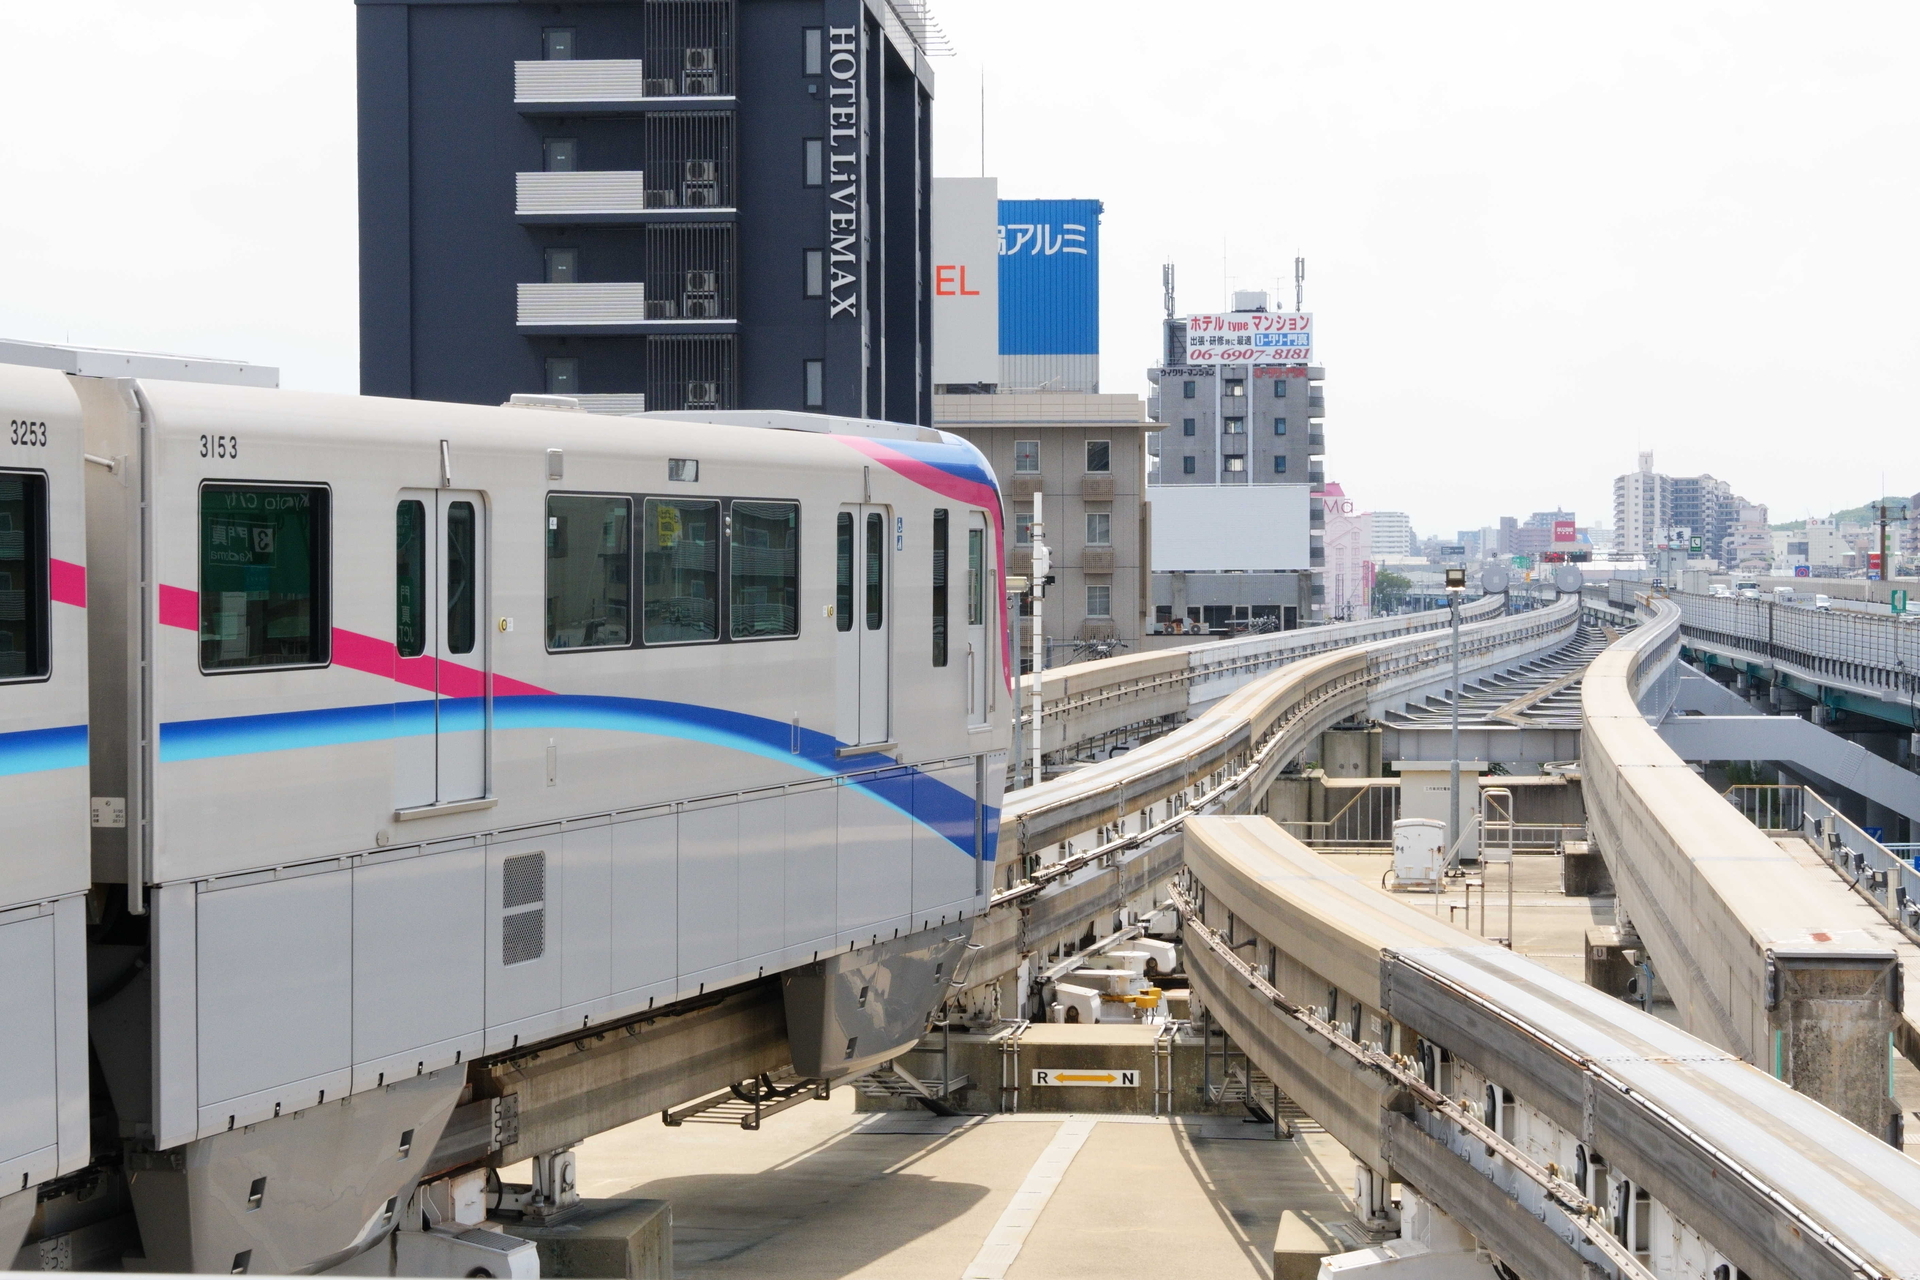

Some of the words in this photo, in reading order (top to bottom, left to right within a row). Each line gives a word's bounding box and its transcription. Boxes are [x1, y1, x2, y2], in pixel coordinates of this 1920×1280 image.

[830, 24, 857, 148] HOTEL
[936, 265, 980, 296] EL
[1190, 316, 1225, 332] ホテル
[1227, 320, 1249, 332] type
[1252, 315, 1310, 332] マンション
[1189, 347, 1310, 362] 06-6907-8181
[10, 420, 47, 447] 3253
[199, 434, 238, 459] 3153
[1037, 1071, 1048, 1084] R
[1122, 1072, 1134, 1085] N
